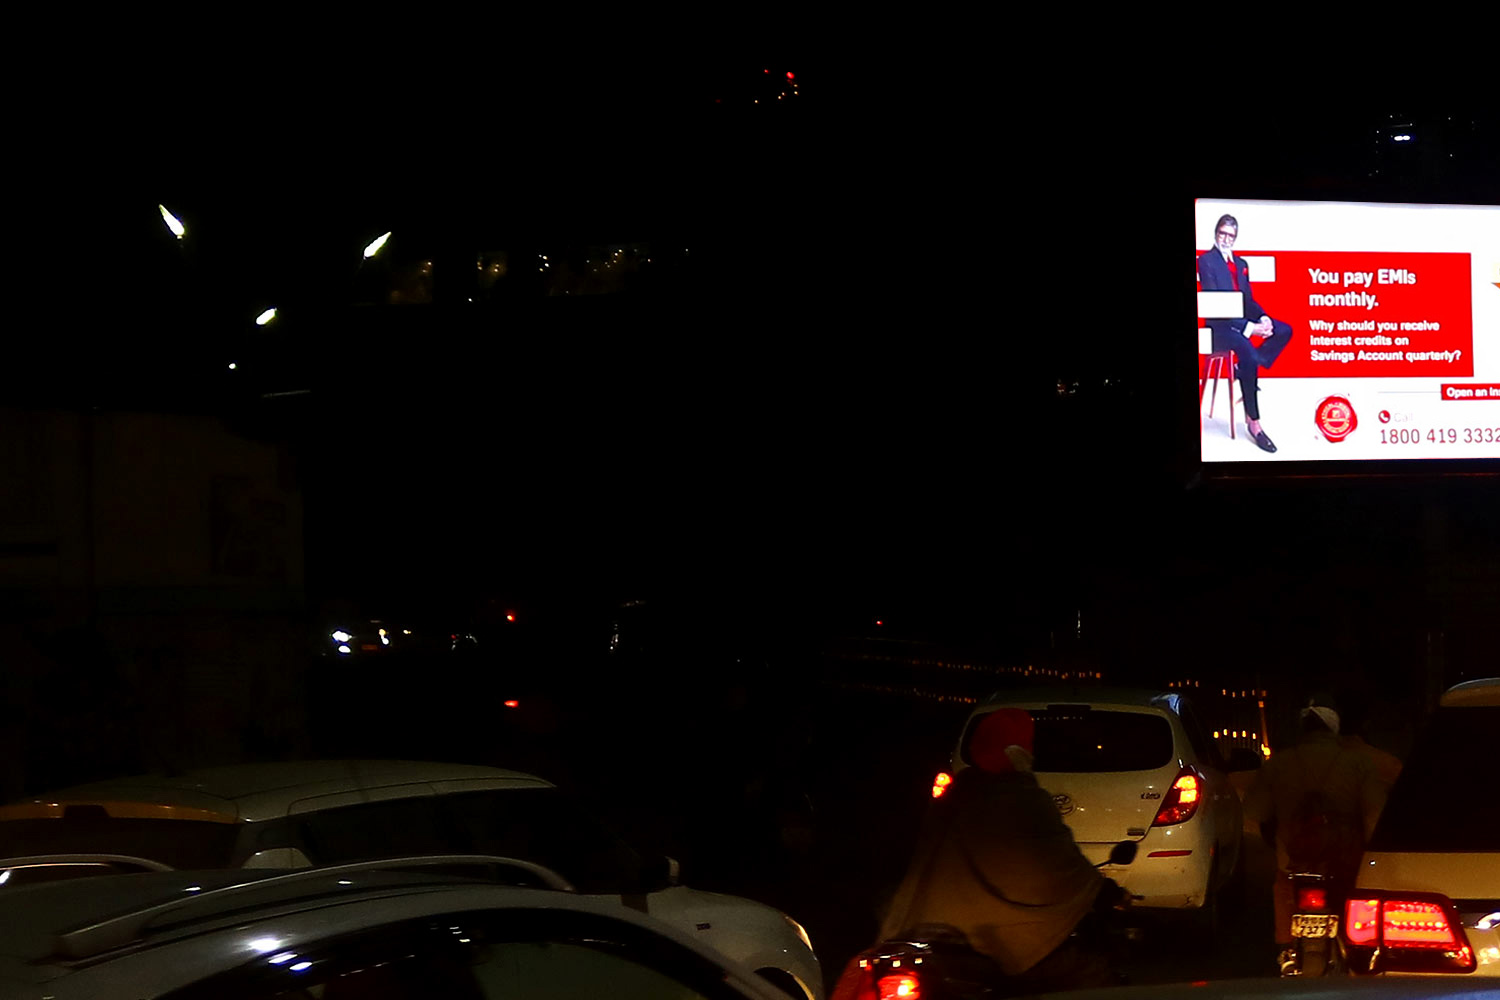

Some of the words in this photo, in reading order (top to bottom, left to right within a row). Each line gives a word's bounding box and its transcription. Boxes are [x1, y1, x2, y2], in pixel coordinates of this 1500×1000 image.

[1308, 268, 1339, 284] You
[1343, 271, 1373, 288] pay
[1377, 269, 1416, 285] EMIs
[1309, 291, 1379, 310] monthly.
[1309, 320, 1335, 333] Why
[1337, 320, 1375, 331] should
[1377, 322, 1398, 333] you
[1400, 320, 1440, 331] receive
[1310, 335, 1352, 346] interest
[1354, 335, 1392, 346] credits
[1394, 337, 1409, 346] on
[1310, 350, 1355, 363] Savings
[1357, 350, 1403, 361] Account
[1405, 350, 1461, 363] quarterly?
[1446, 387, 1473, 399] Open
[1475, 388, 1488, 397] an
[1381, 428, 1420, 444] 1800
[1426, 428, 1457, 444] 419
